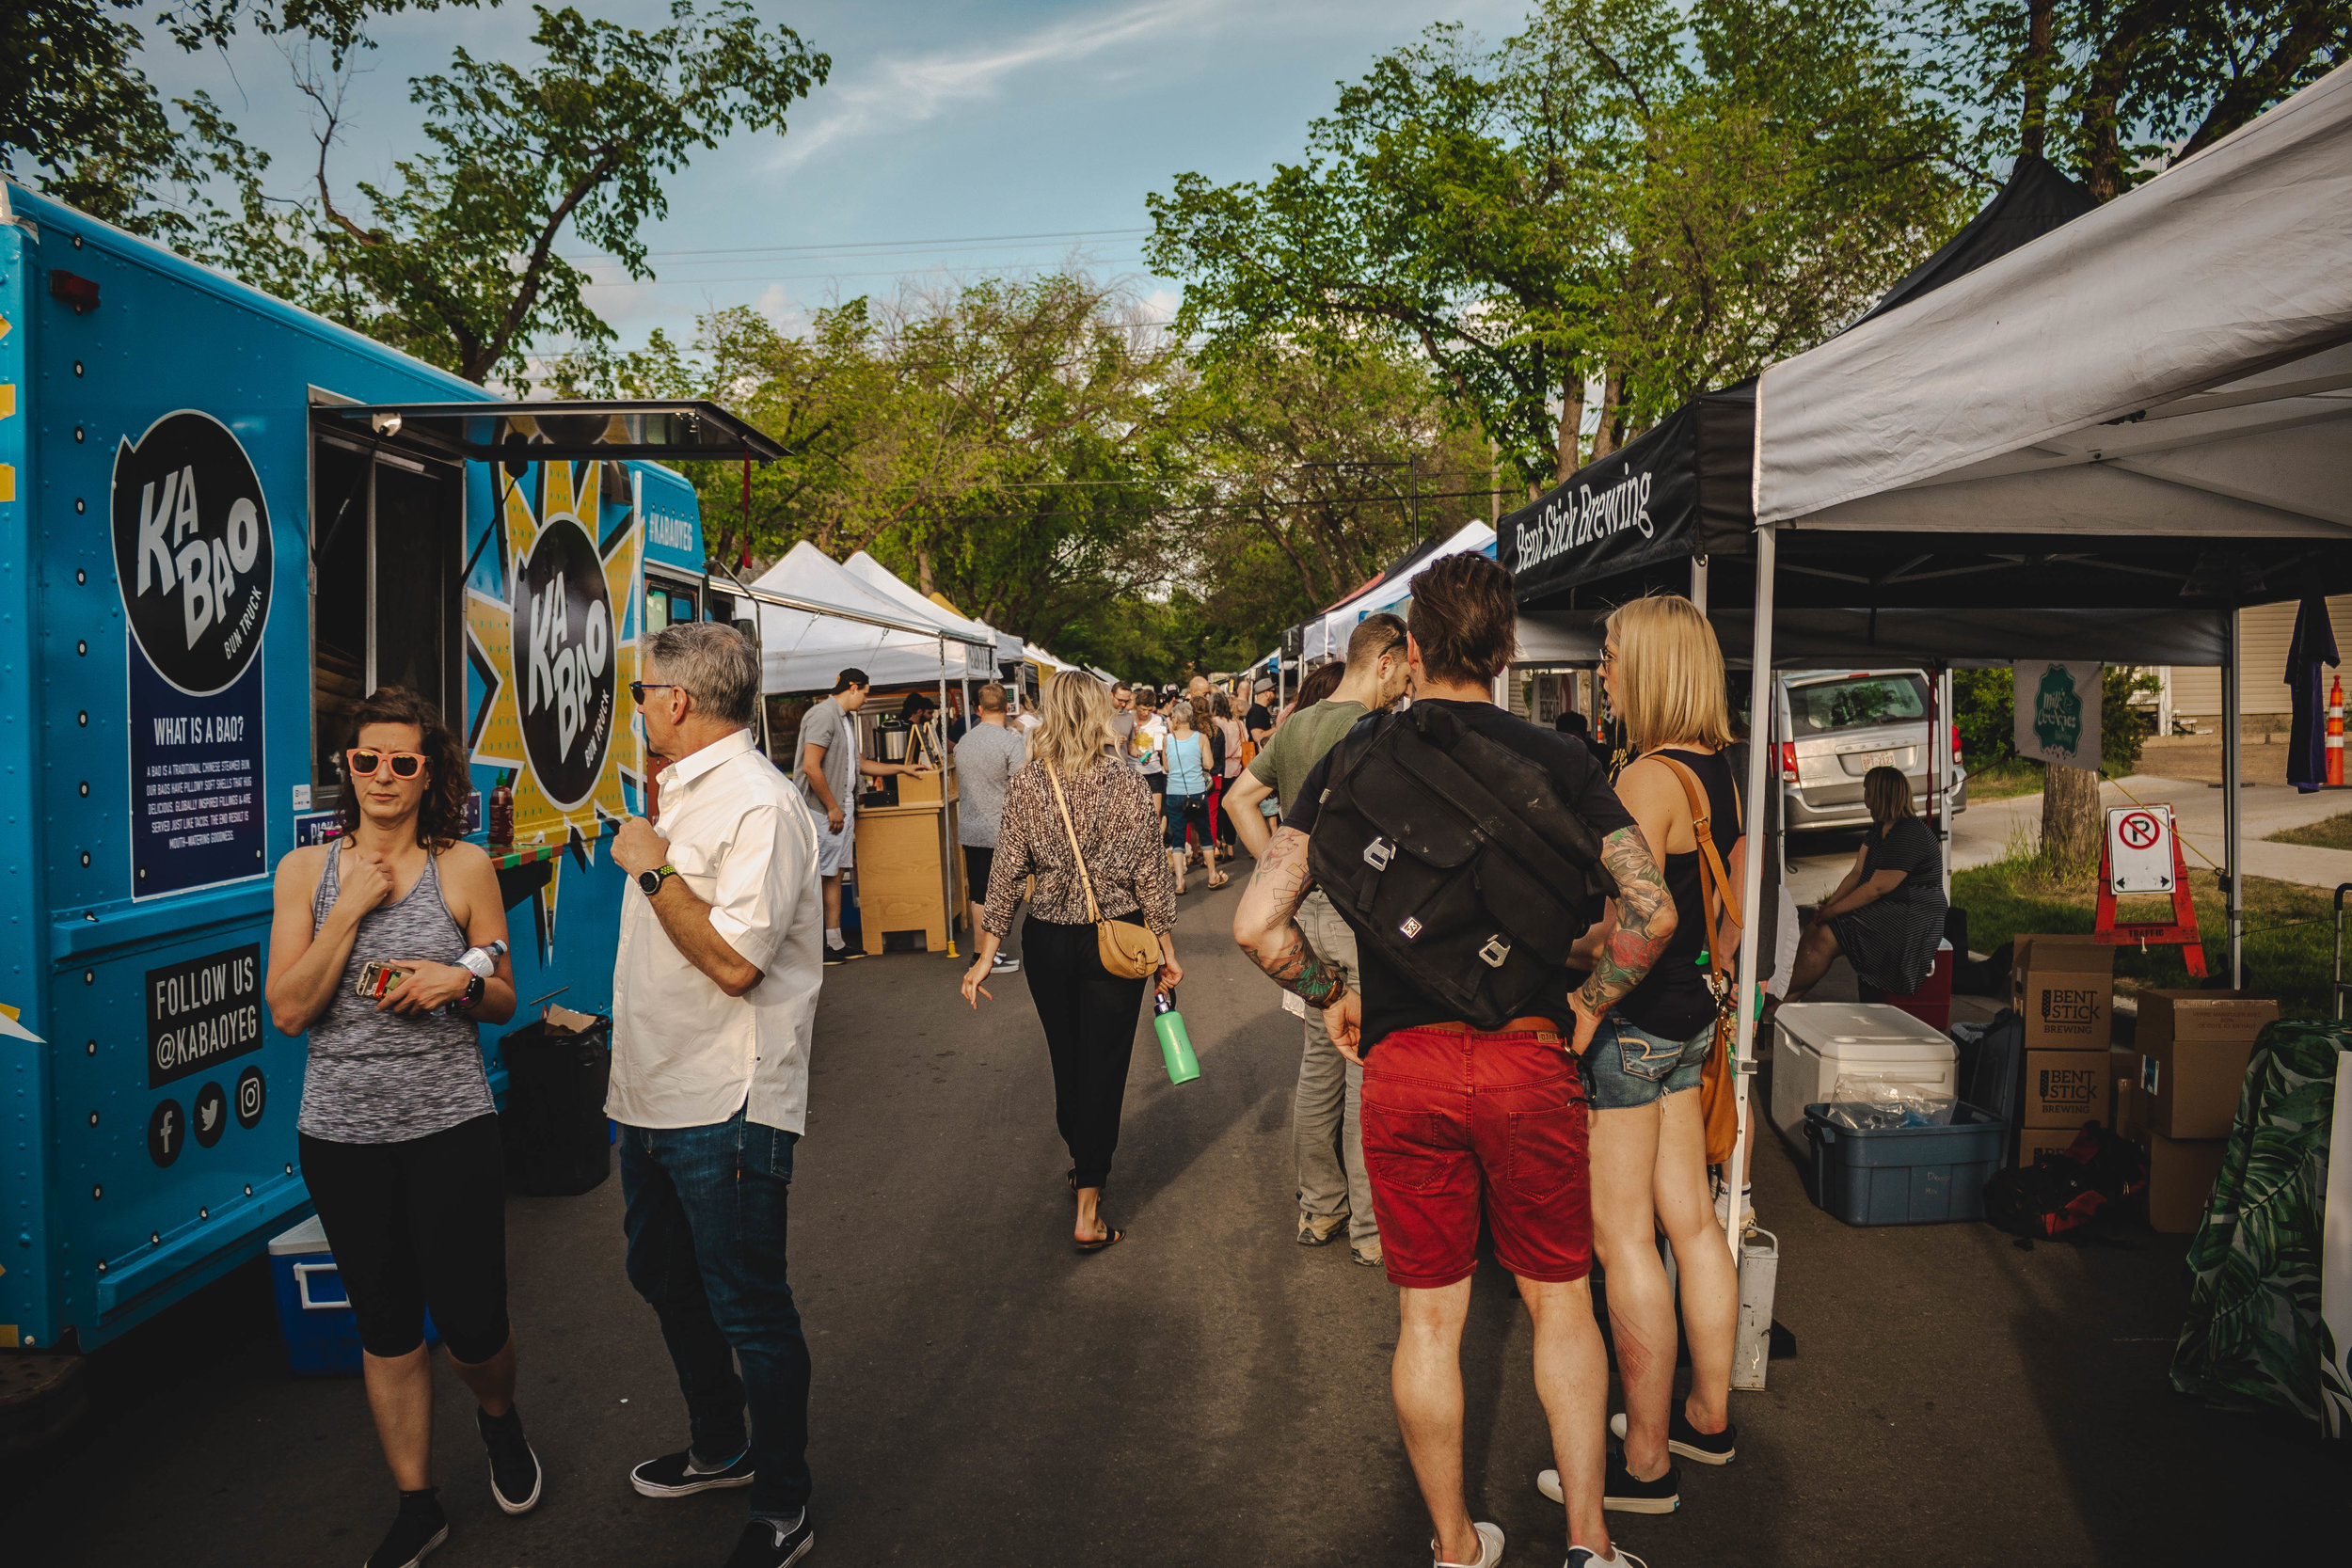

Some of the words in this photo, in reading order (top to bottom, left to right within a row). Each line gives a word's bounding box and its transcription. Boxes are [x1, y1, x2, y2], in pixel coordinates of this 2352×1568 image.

[1515, 515, 1544, 575] Bent
[1542, 490, 1579, 561] Stick
[1575, 462, 1654, 547] Brewing
[648, 512, 693, 552] #KABAOYEG
[224, 625, 244, 660] BUN
[239, 585, 262, 637] TRUCK
[153, 717, 187, 746] WHAT
[191, 717, 202, 744] IS
[205, 717, 214, 743] A
[216, 716, 245, 743] BAO?
[584, 736, 598, 768] BUN
[594, 689, 611, 744] TRUCK
[146, 766, 151, 777] A
[151, 765, 161, 777] BAO
[162, 765, 167, 776] IS
[168, 765, 172, 776] A
[172, 763, 201, 776] TRADITIONAL
[202, 761, 221, 773] CHINESE
[221, 760, 241, 772] STEAMED
[147, 784, 156, 797] OUR
[157, 783, 170, 796] BAOS
[171, 782, 183, 795] HAVE
[183, 780, 203, 794] PILLOWY
[204, 779, 215, 791] SOFT
[216, 778, 232, 790] SHELLS
[232, 777, 243, 789] THAT
[243, 776, 252, 788] HUG
[175, 799, 198, 813] GLOBALLY
[199, 796, 218, 811] INSPIRED
[219, 795, 238, 809] FILLINGS
[243, 793, 251, 805] ARE
[151, 820, 170, 834] SERVED
[171, 818, 183, 832] JUST
[183, 817, 194, 830] LIKE
[210, 814, 219, 826] THE
[219, 813, 228, 825] END
[229, 811, 244, 824] RESULT
[245, 810, 249, 822] IS
[2132, 820, 2150, 842] P
[2128, 928, 2164, 938] TRAFFIC
[156, 963, 227, 1020] FOLLOW
[232, 956, 254, 996] US
[2053, 990, 2097, 1004] BENT
[2052, 1005, 2100, 1020] STICK
[156, 1005, 257, 1069] @KABAOYEG
[2043, 1024, 2092, 1035] BREWING
[2051, 1069, 2095, 1084] BENT
[2050, 1085, 2098, 1100] STICK
[2042, 1104, 2090, 1115] BREWING
